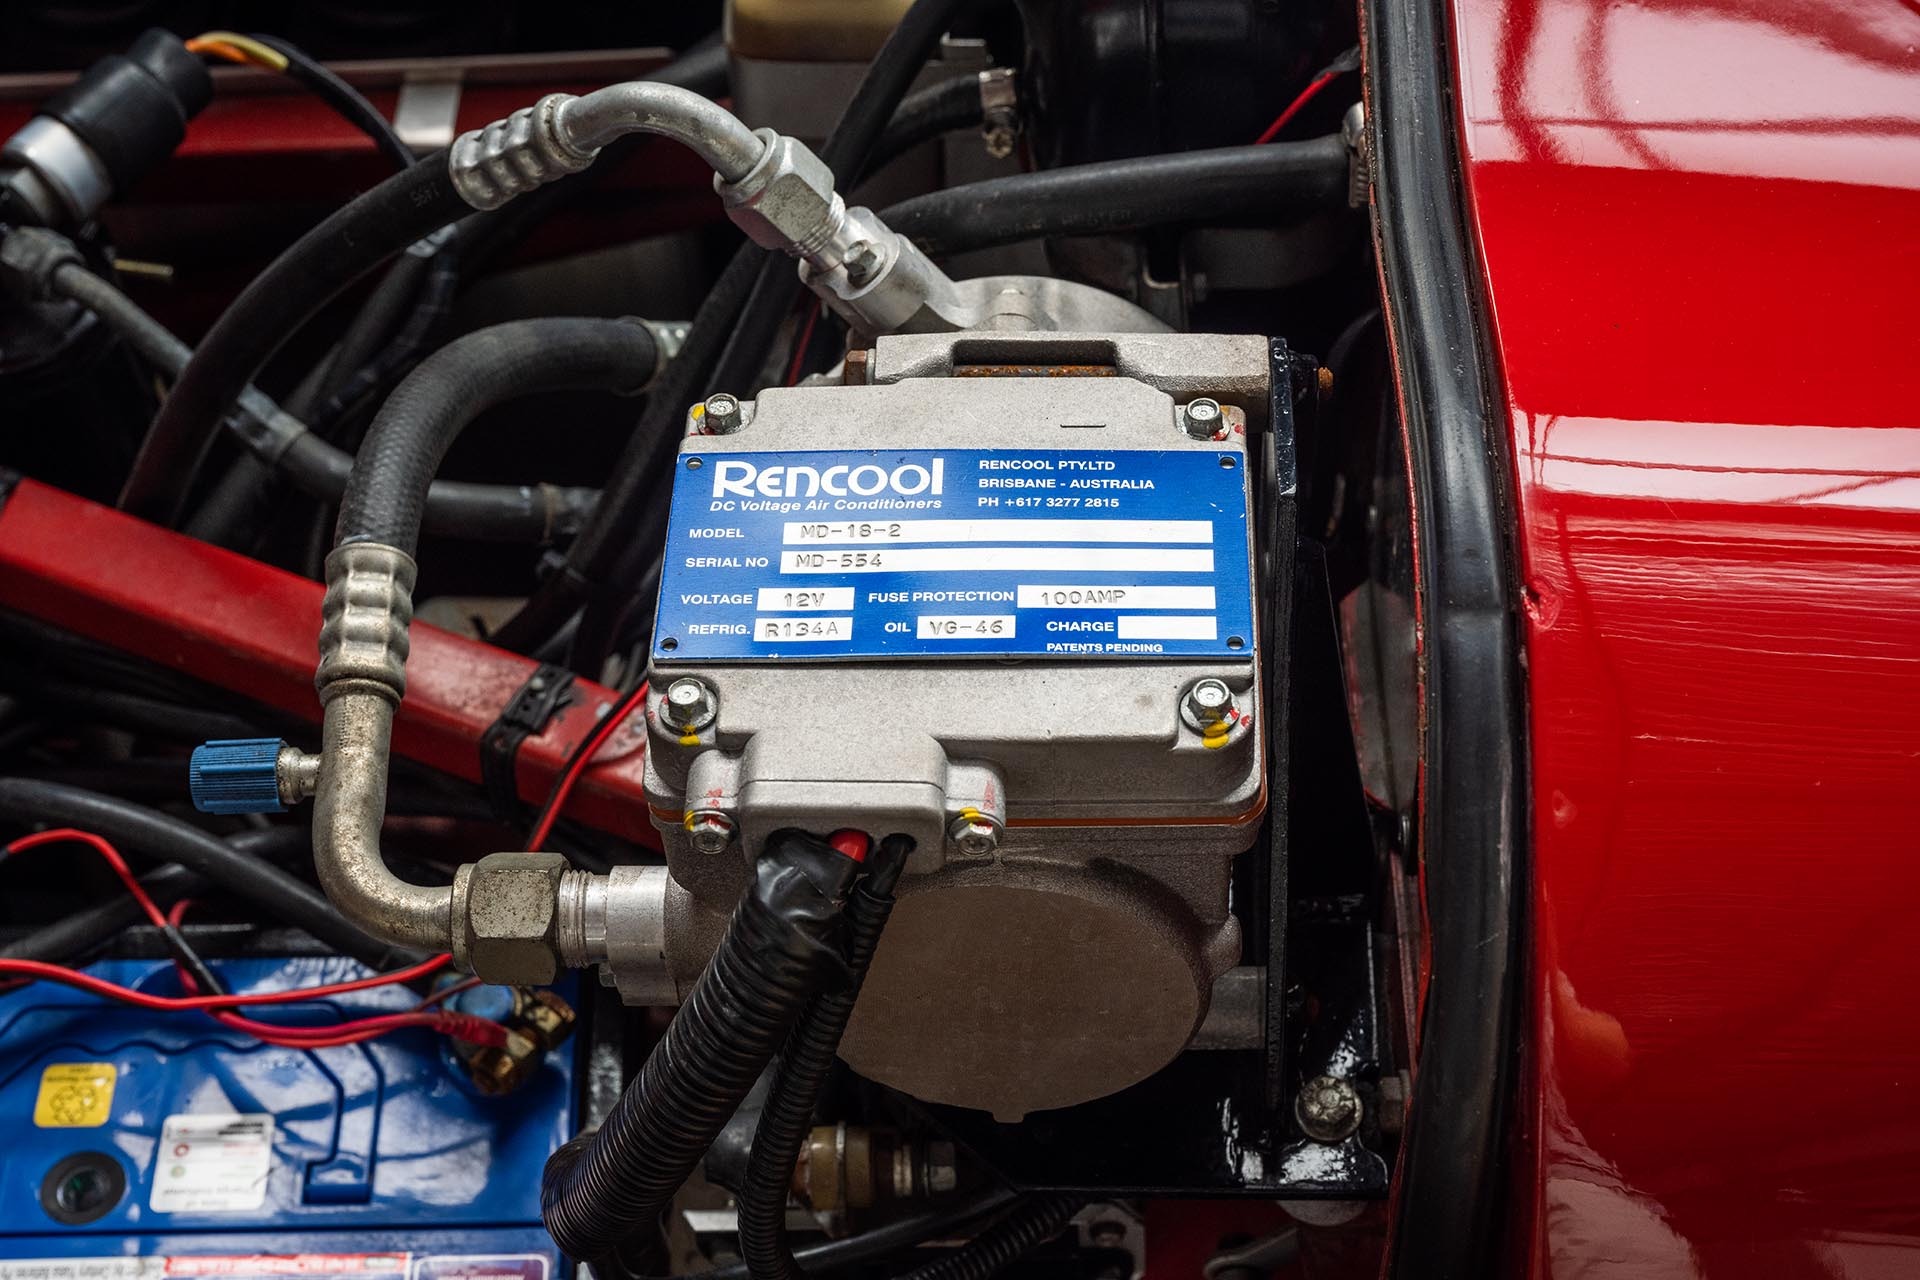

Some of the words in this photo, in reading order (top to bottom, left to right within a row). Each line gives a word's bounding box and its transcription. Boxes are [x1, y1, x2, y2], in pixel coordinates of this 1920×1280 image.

[979, 460, 1054, 470] RENCOOL
[1058, 460, 1116, 471] PTY.LTD
[978, 478, 1056, 488] BRISBANE
[1070, 479, 1155, 490] AUSTRALIA
[710, 500, 736, 512] DC
[740, 500, 801, 514] Voltage
[805, 500, 830, 512] Air
[834, 499, 942, 511] Conditioners
[978, 497, 999, 507] PH
[1005, 497, 1042, 508] +617
[1046, 498, 1080, 508] 3277
[1085, 498, 1120, 508] 2815
[689, 528, 744, 538] MODEL
[686, 557, 742, 568] SERIAL
[745, 557, 769, 568] NO
[795, 553, 882, 568] MD-554
[680, 594, 753, 604] VOLTAGE
[784, 592, 826, 607] 12V
[868, 592, 909, 603] FUSE
[912, 591, 1014, 602] PROTECTION
[1040, 590, 1126, 606] 100AMP
[688, 624, 750, 635] REFRIG.
[764, 622, 838, 638] R134A
[884, 622, 912, 633] OIL
[930, 620, 1004, 636] VG-46
[1046, 621, 1114, 632] CHARGE
[1046, 643, 1103, 652] PATENTS
[1106, 644, 1163, 653] PENDING
